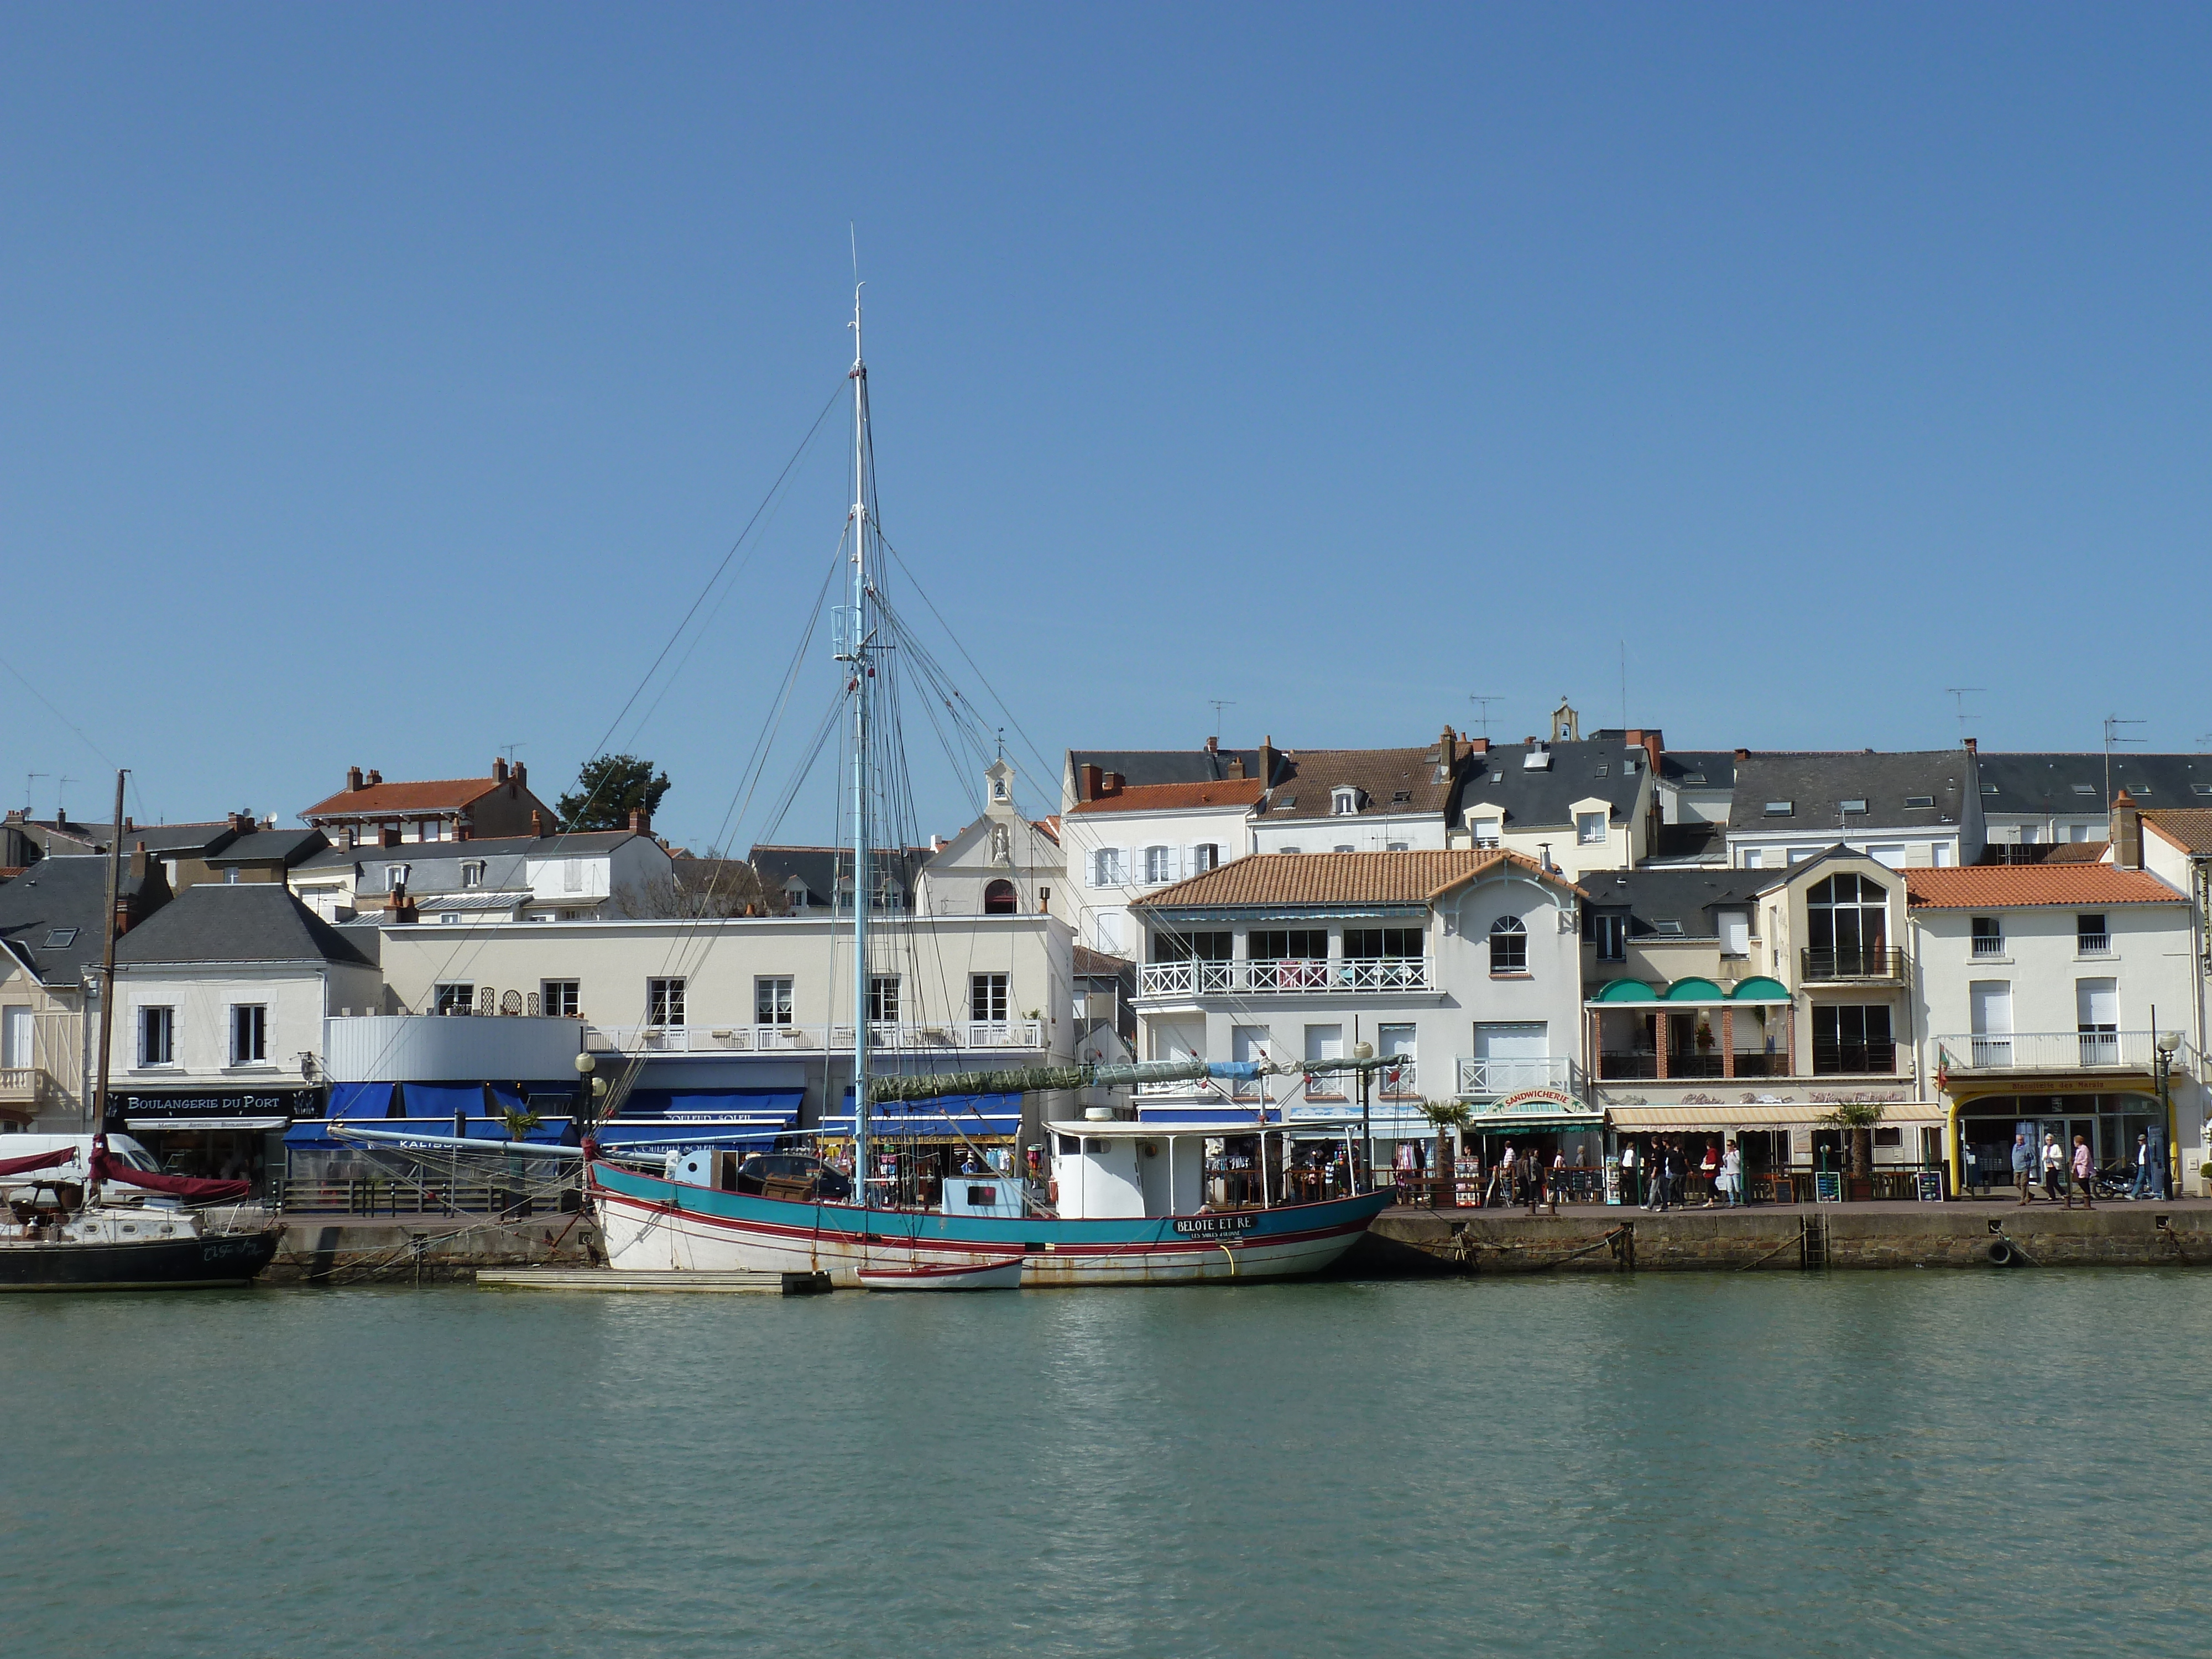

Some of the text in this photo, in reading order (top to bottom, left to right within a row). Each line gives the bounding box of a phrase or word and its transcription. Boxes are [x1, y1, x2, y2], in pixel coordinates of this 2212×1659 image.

[128, 1096, 279, 1109] BOULANGERIE DU PORT
[1505, 1091, 1569, 1107] SANDWICHERIE
[1177, 1217, 1251, 1232] BELOTE ET RE
